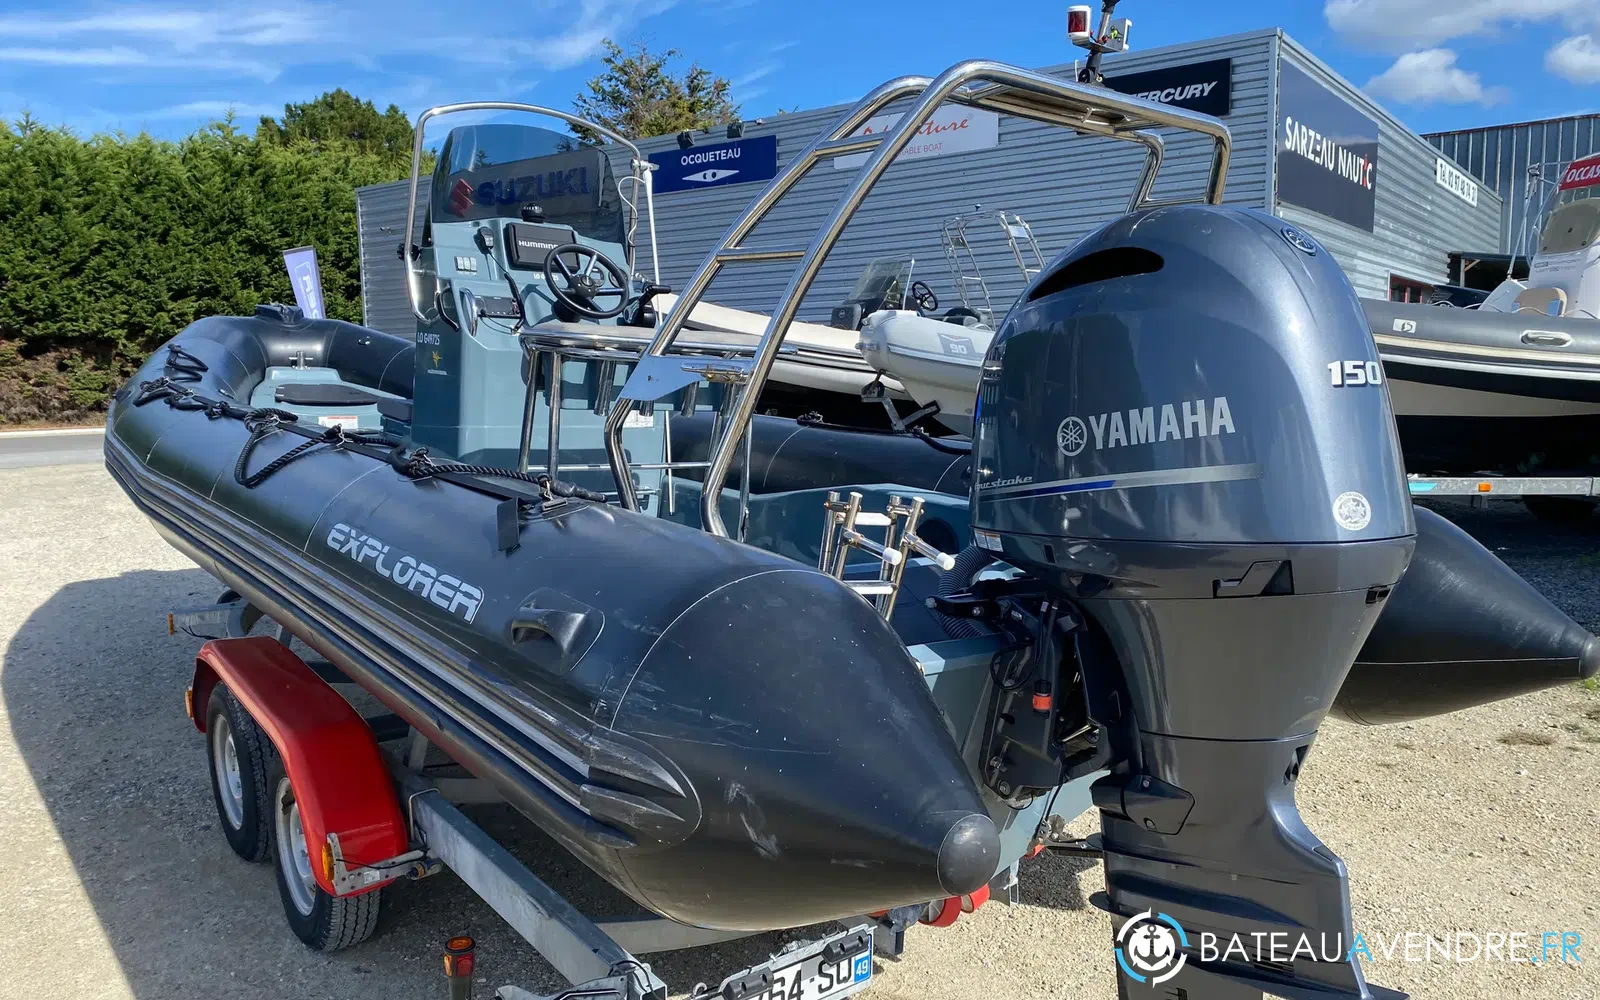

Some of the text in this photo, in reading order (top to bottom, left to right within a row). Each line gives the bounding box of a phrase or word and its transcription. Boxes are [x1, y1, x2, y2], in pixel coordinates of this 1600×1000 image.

[1130, 81, 1218, 103] ERCURY
[680, 147, 741, 166] OCQUETEAU
[924, 143, 942, 152] BOAT
[1285, 116, 1335, 171] SARZEAU
[477, 167, 591, 206] SUZUKI
[1327, 360, 1382, 387] 150
[1088, 396, 1236, 450] YAMAHA
[326, 522, 485, 625] EXPLORER
[856, 960, 869, 977] 49
